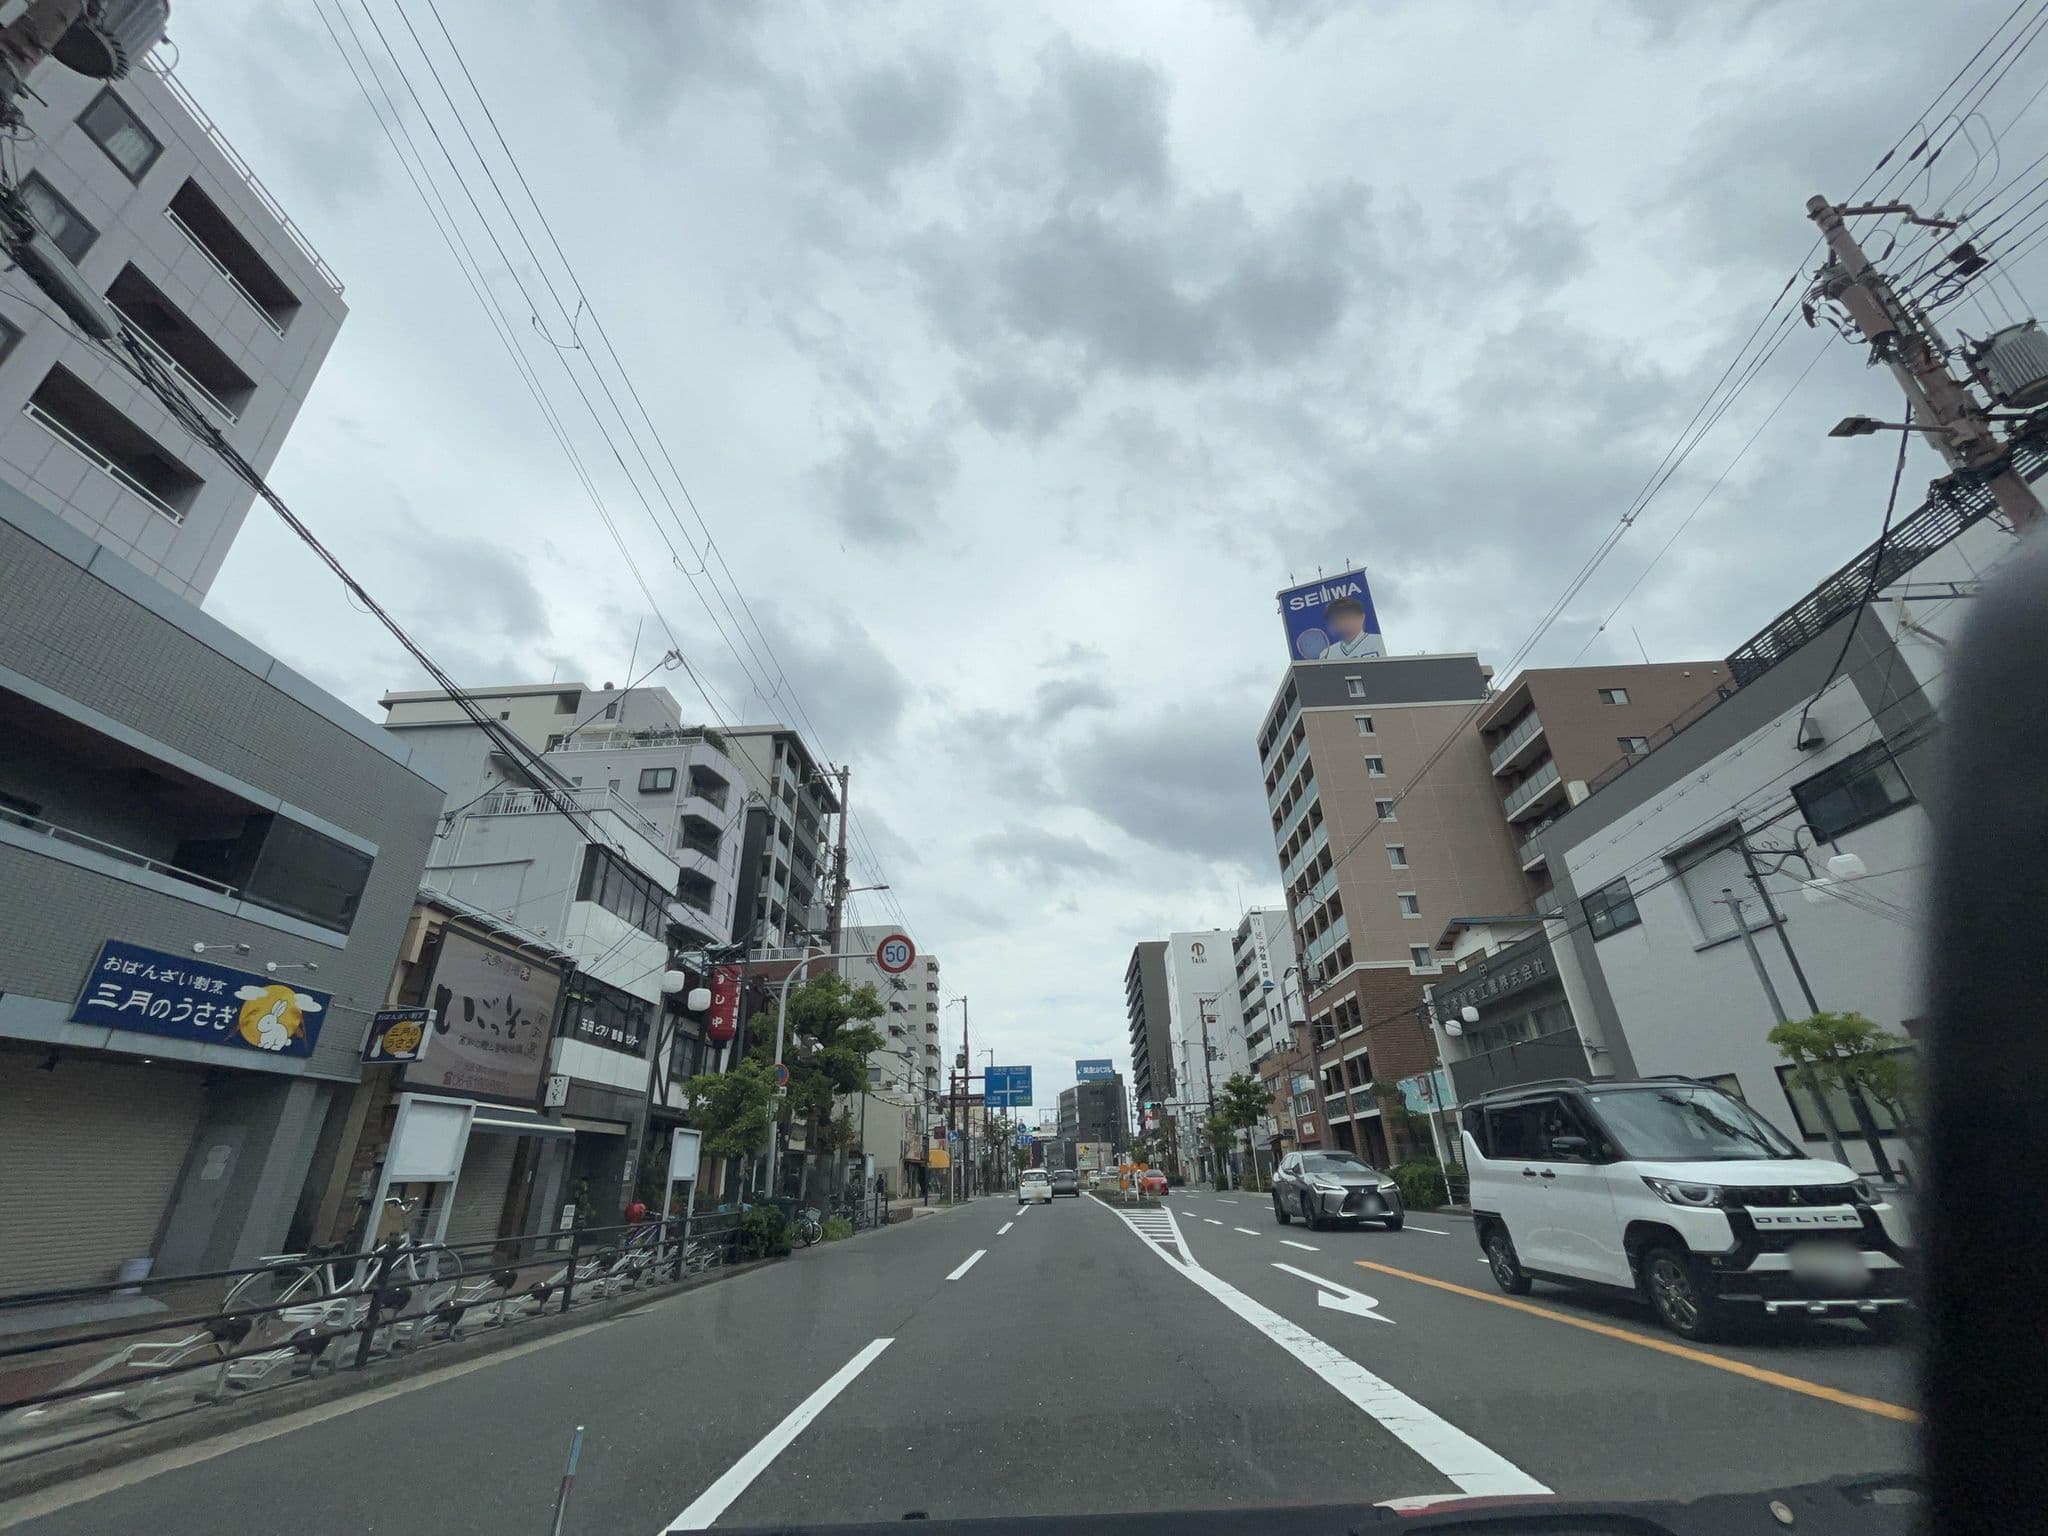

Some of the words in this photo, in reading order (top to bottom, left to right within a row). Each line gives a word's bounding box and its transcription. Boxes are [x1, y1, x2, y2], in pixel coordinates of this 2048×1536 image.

[886, 945, 907, 962] 50
[103, 956, 229, 996] おばんざい割烹
[88, 983, 237, 1030] 三月のうさぎ
[1754, 1215, 1859, 1224] DELICA
